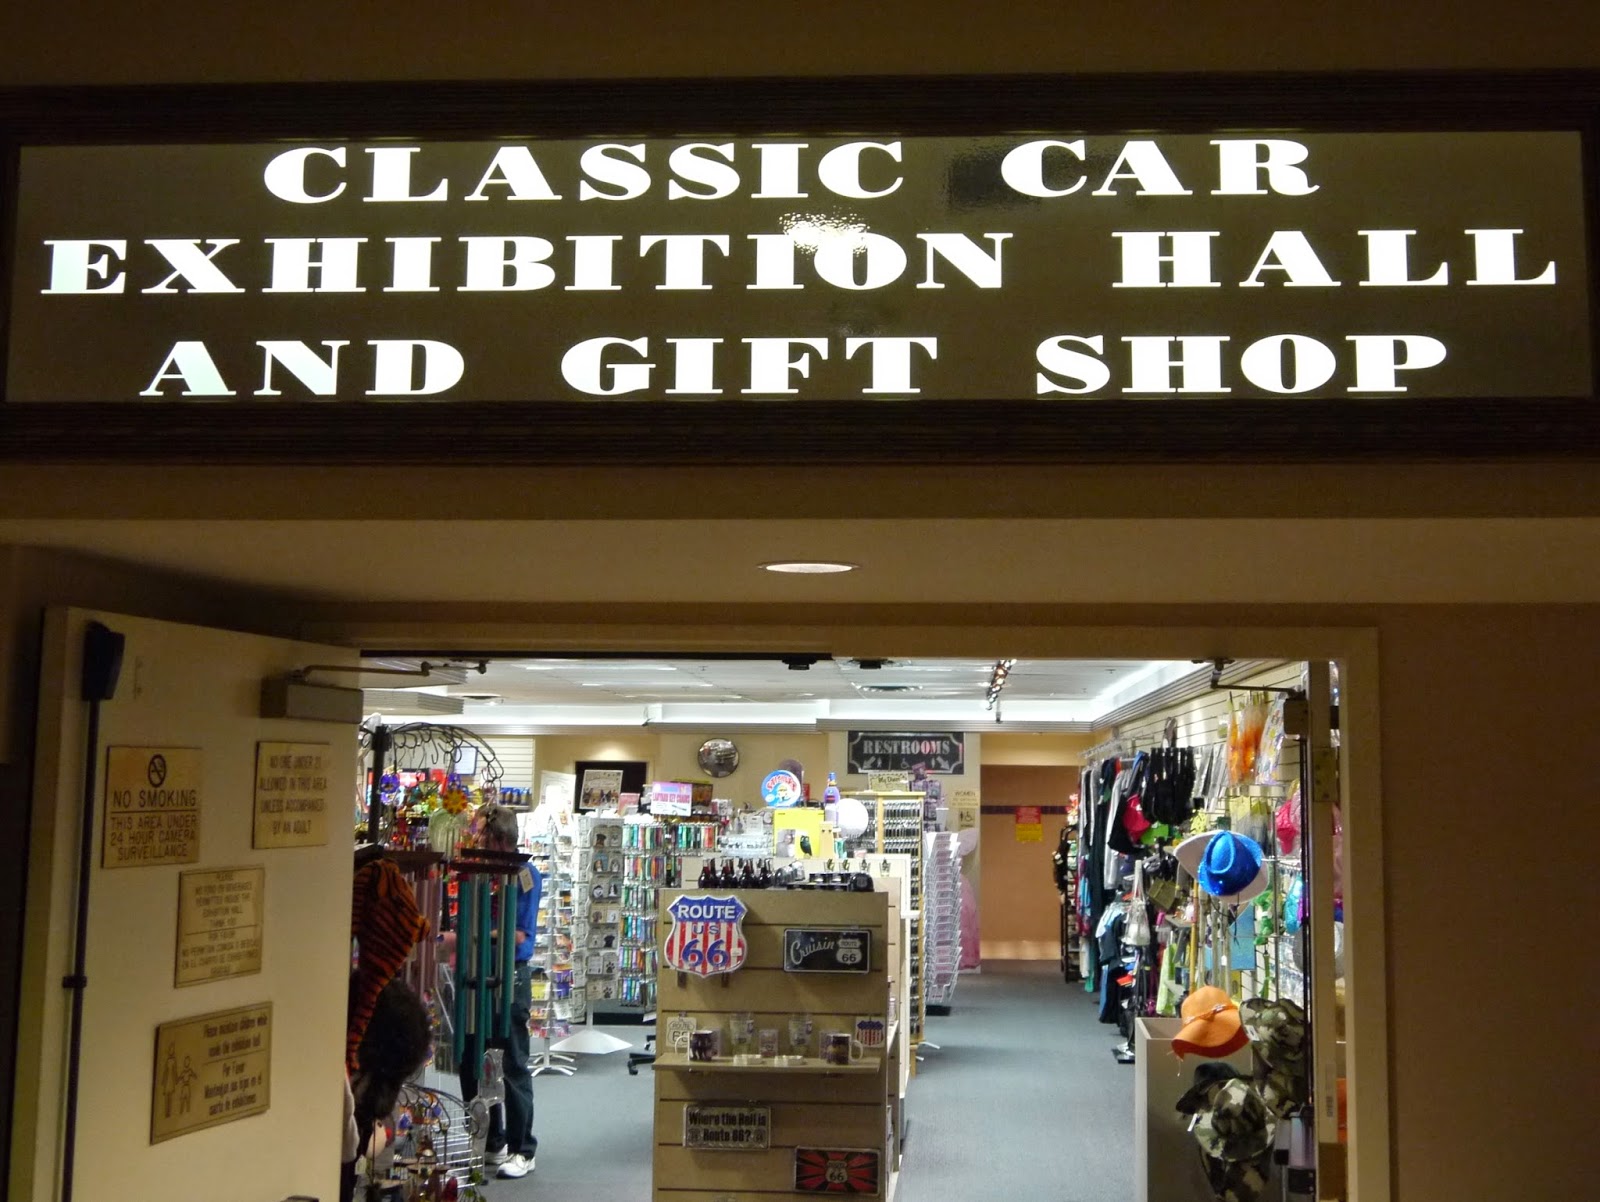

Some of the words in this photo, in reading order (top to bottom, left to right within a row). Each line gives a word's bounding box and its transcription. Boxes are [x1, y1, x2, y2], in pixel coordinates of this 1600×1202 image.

[264, 141, 904, 203] CLASSIC
[1001, 140, 1320, 198] CAR
[41, 233, 1013, 294] EXHIBITION
[1112, 229, 1556, 288] HALL
[140, 340, 464, 396] AND
[561, 337, 937, 395] GIFT
[1036, 334, 1446, 394] SHOP
[863, 740, 950, 754] RESTROOMS
[113, 789, 131, 808] NO
[139, 789, 197, 808] SMOKING
[111, 816, 133, 830] THIS
[138, 815, 162, 830] AREA
[168, 814, 197, 828] UNDER
[111, 832, 123, 847] 24
[129, 831, 154, 845] HOUR
[159, 829, 196, 843] CAMERA
[118, 843, 187, 860] SURVEILLANCE
[678, 905, 736, 919] ROUTE
[682, 939, 728, 968] 66
[790, 937, 835, 965] Cruisin
[842, 953, 857, 963] 66
[689, 1111, 720, 1125] Where
[721, 1112, 736, 1125] the
[738, 1112, 756, 1126] Hell
[758, 1112, 767, 1126] is
[703, 1128, 730, 1141] Route
[732, 1129, 751, 1142] 66?
[830, 1172, 844, 1180] 66
